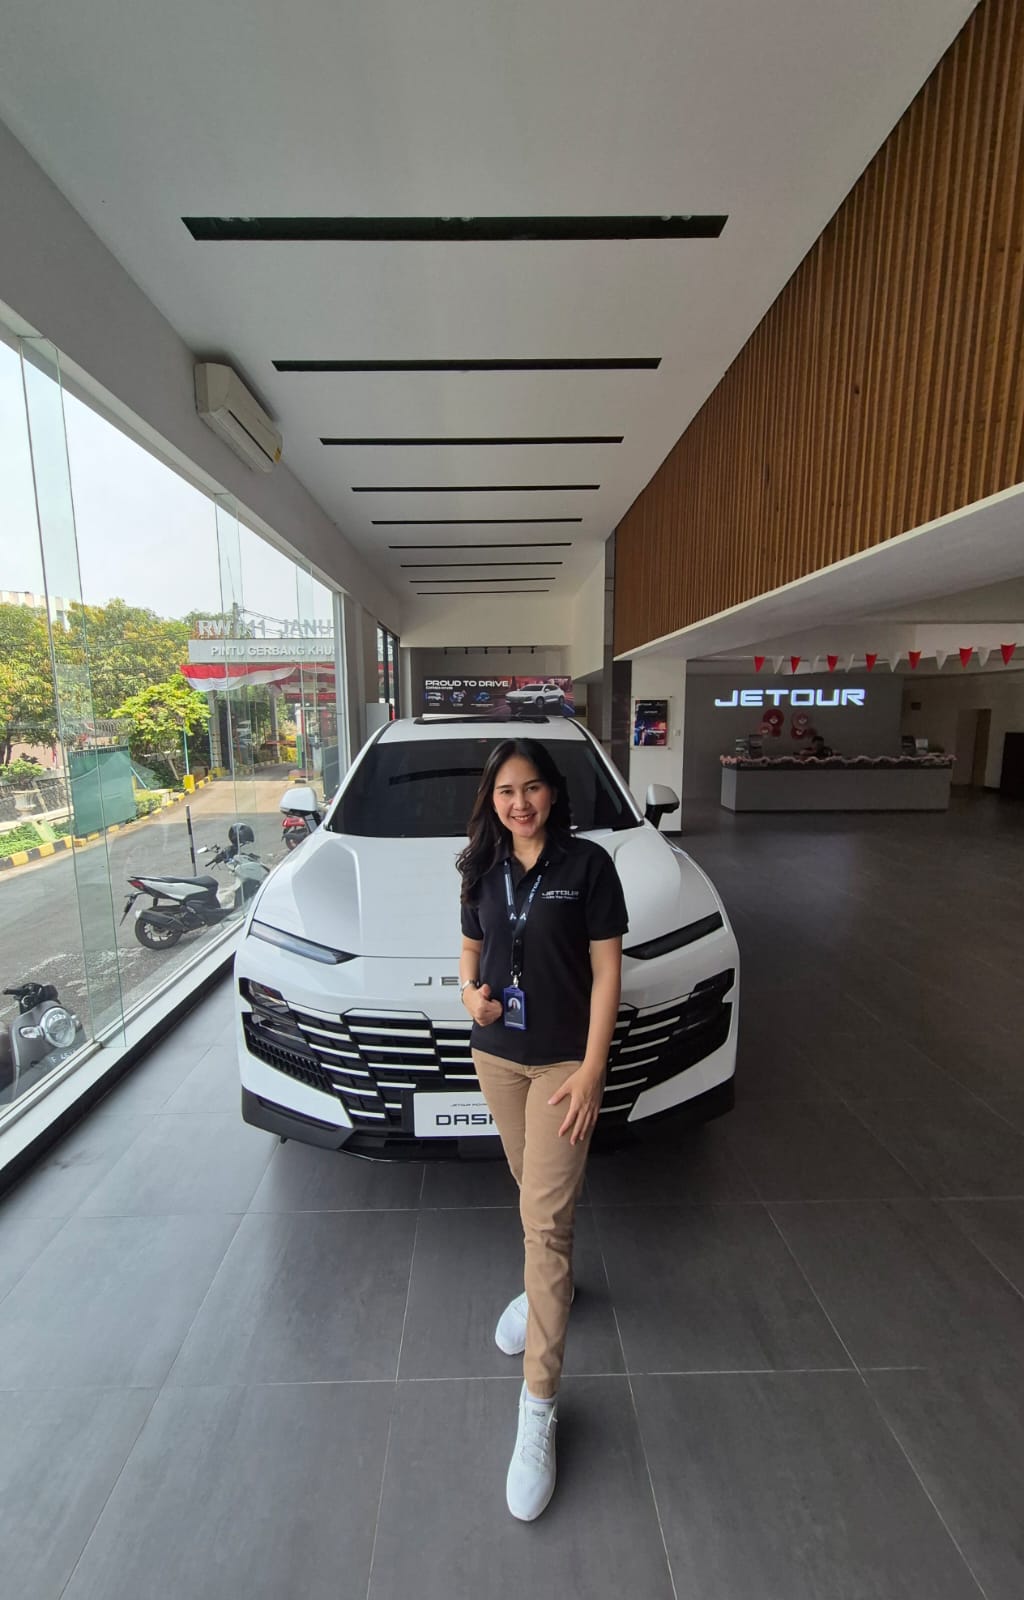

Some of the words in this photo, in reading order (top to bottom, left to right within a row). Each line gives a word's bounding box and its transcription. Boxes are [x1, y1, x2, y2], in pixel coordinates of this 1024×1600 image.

[198, 620, 231, 637] RW
[211, 647, 243, 656] PINTU
[249, 647, 305, 657] GERBANG
[714, 688, 866, 707] JETOUR
